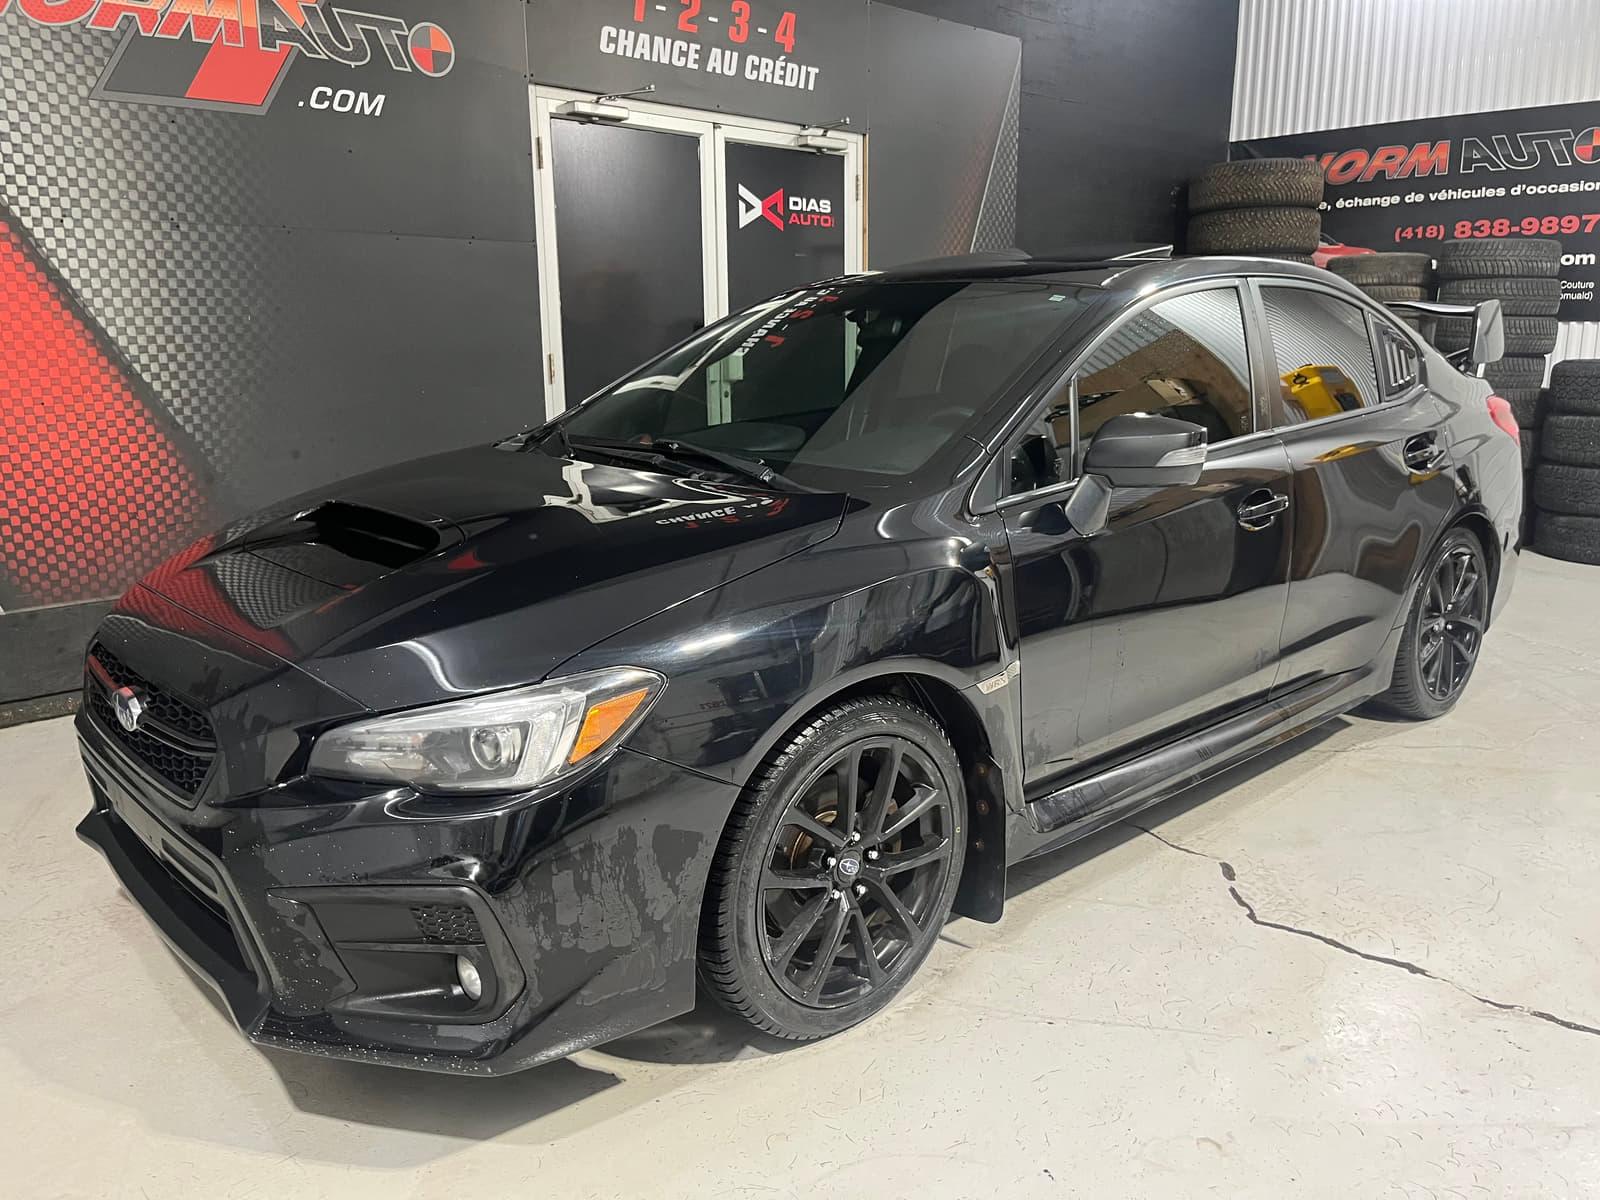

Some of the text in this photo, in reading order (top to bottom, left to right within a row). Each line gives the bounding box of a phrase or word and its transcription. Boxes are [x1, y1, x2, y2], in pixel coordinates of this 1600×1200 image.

[255, 0, 456, 77] AUTO
[600, 25, 819, 91] CHANCE AU CRÉDIT
[298, 86, 386, 117] .COM
[788, 196, 833, 228] DIAS AUTO
[1335, 194, 1401, 209] échange
[1404, 191, 1425, 204] de
[1428, 186, 1506, 202] véhicules
[1394, 213, 1600, 243] (418) 838-9897
